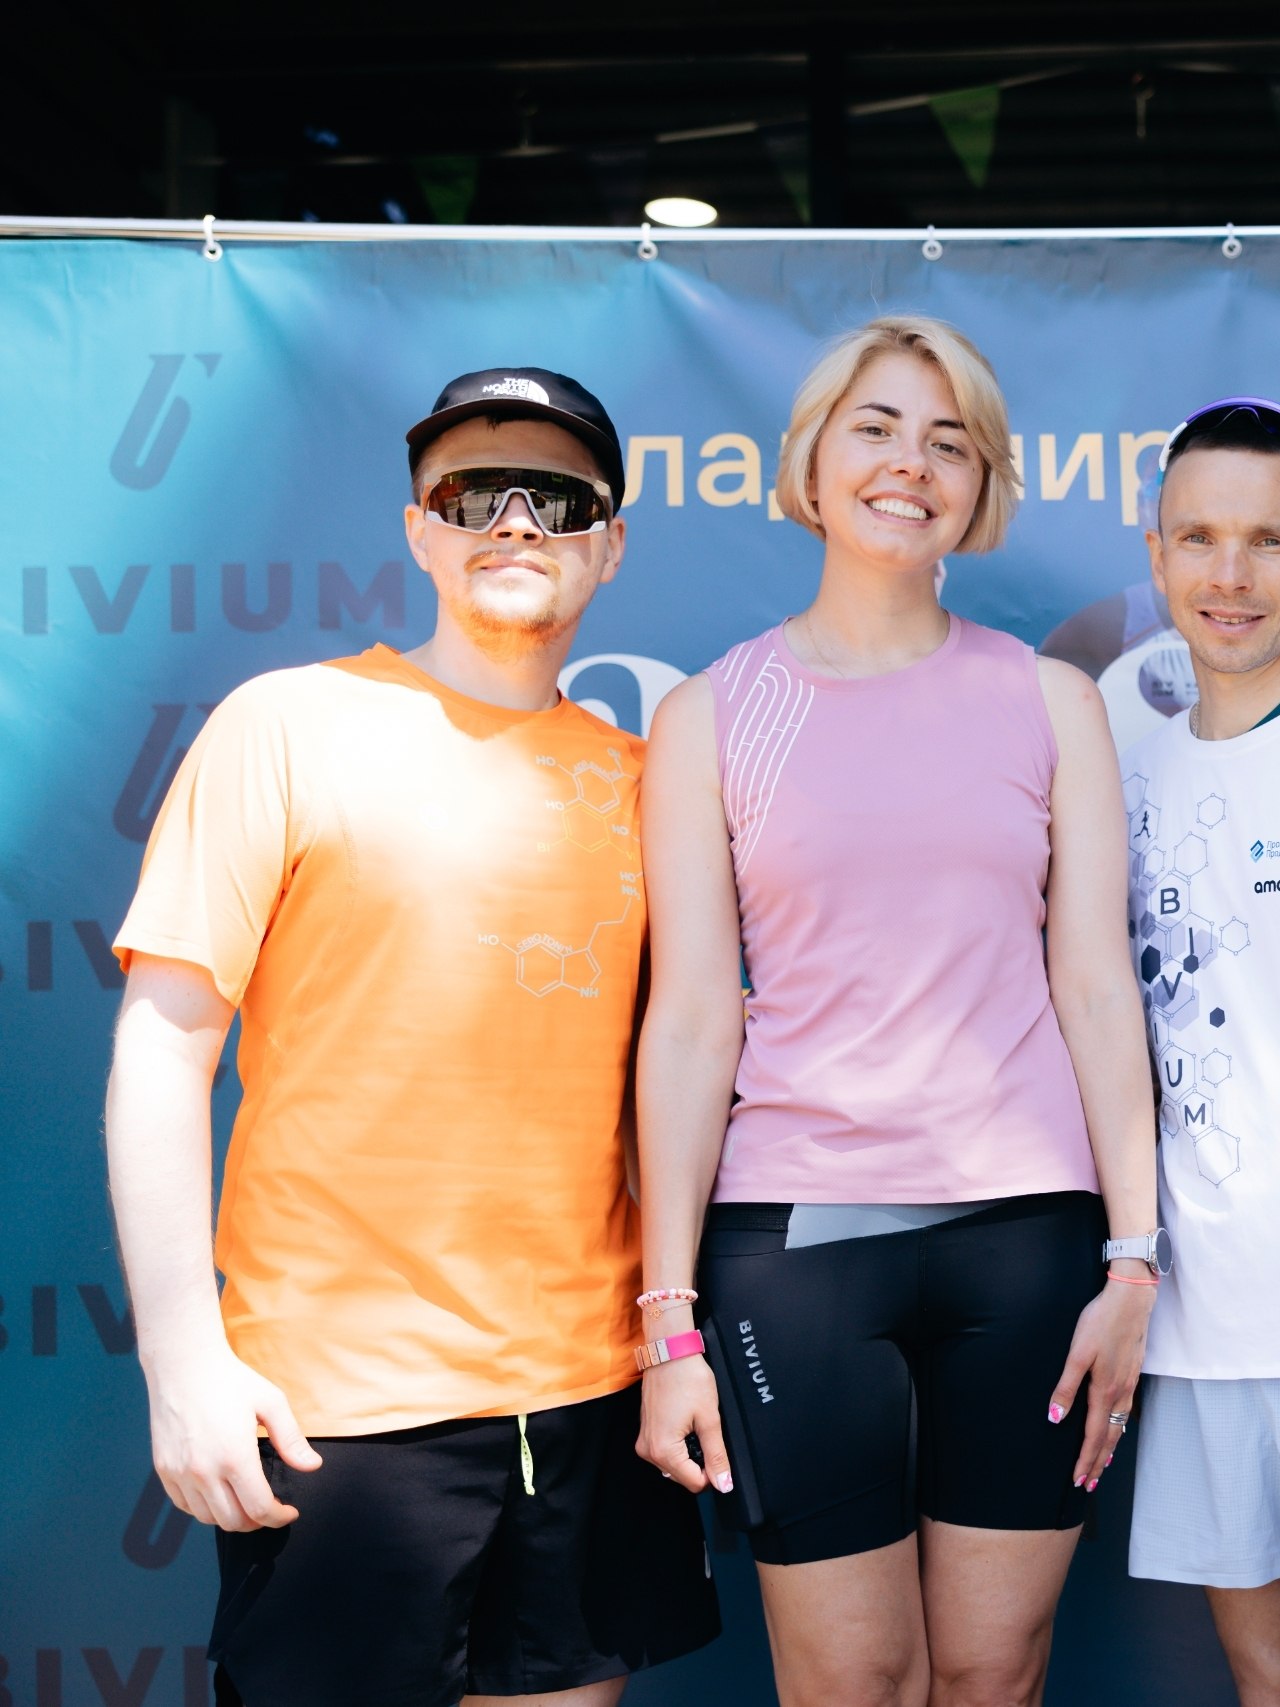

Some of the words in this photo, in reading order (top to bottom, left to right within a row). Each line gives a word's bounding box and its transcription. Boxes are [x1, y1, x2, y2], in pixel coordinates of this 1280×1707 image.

[503, 377, 529, 386] THE
[482, 383, 528, 393] NORTH
[22, 561, 407, 635] IVIUM
[535, 755, 556, 767] HO
[477, 933, 500, 946] HO
[579, 987, 599, 998] NH
[739, 1319, 775, 1404] BIVIUM
